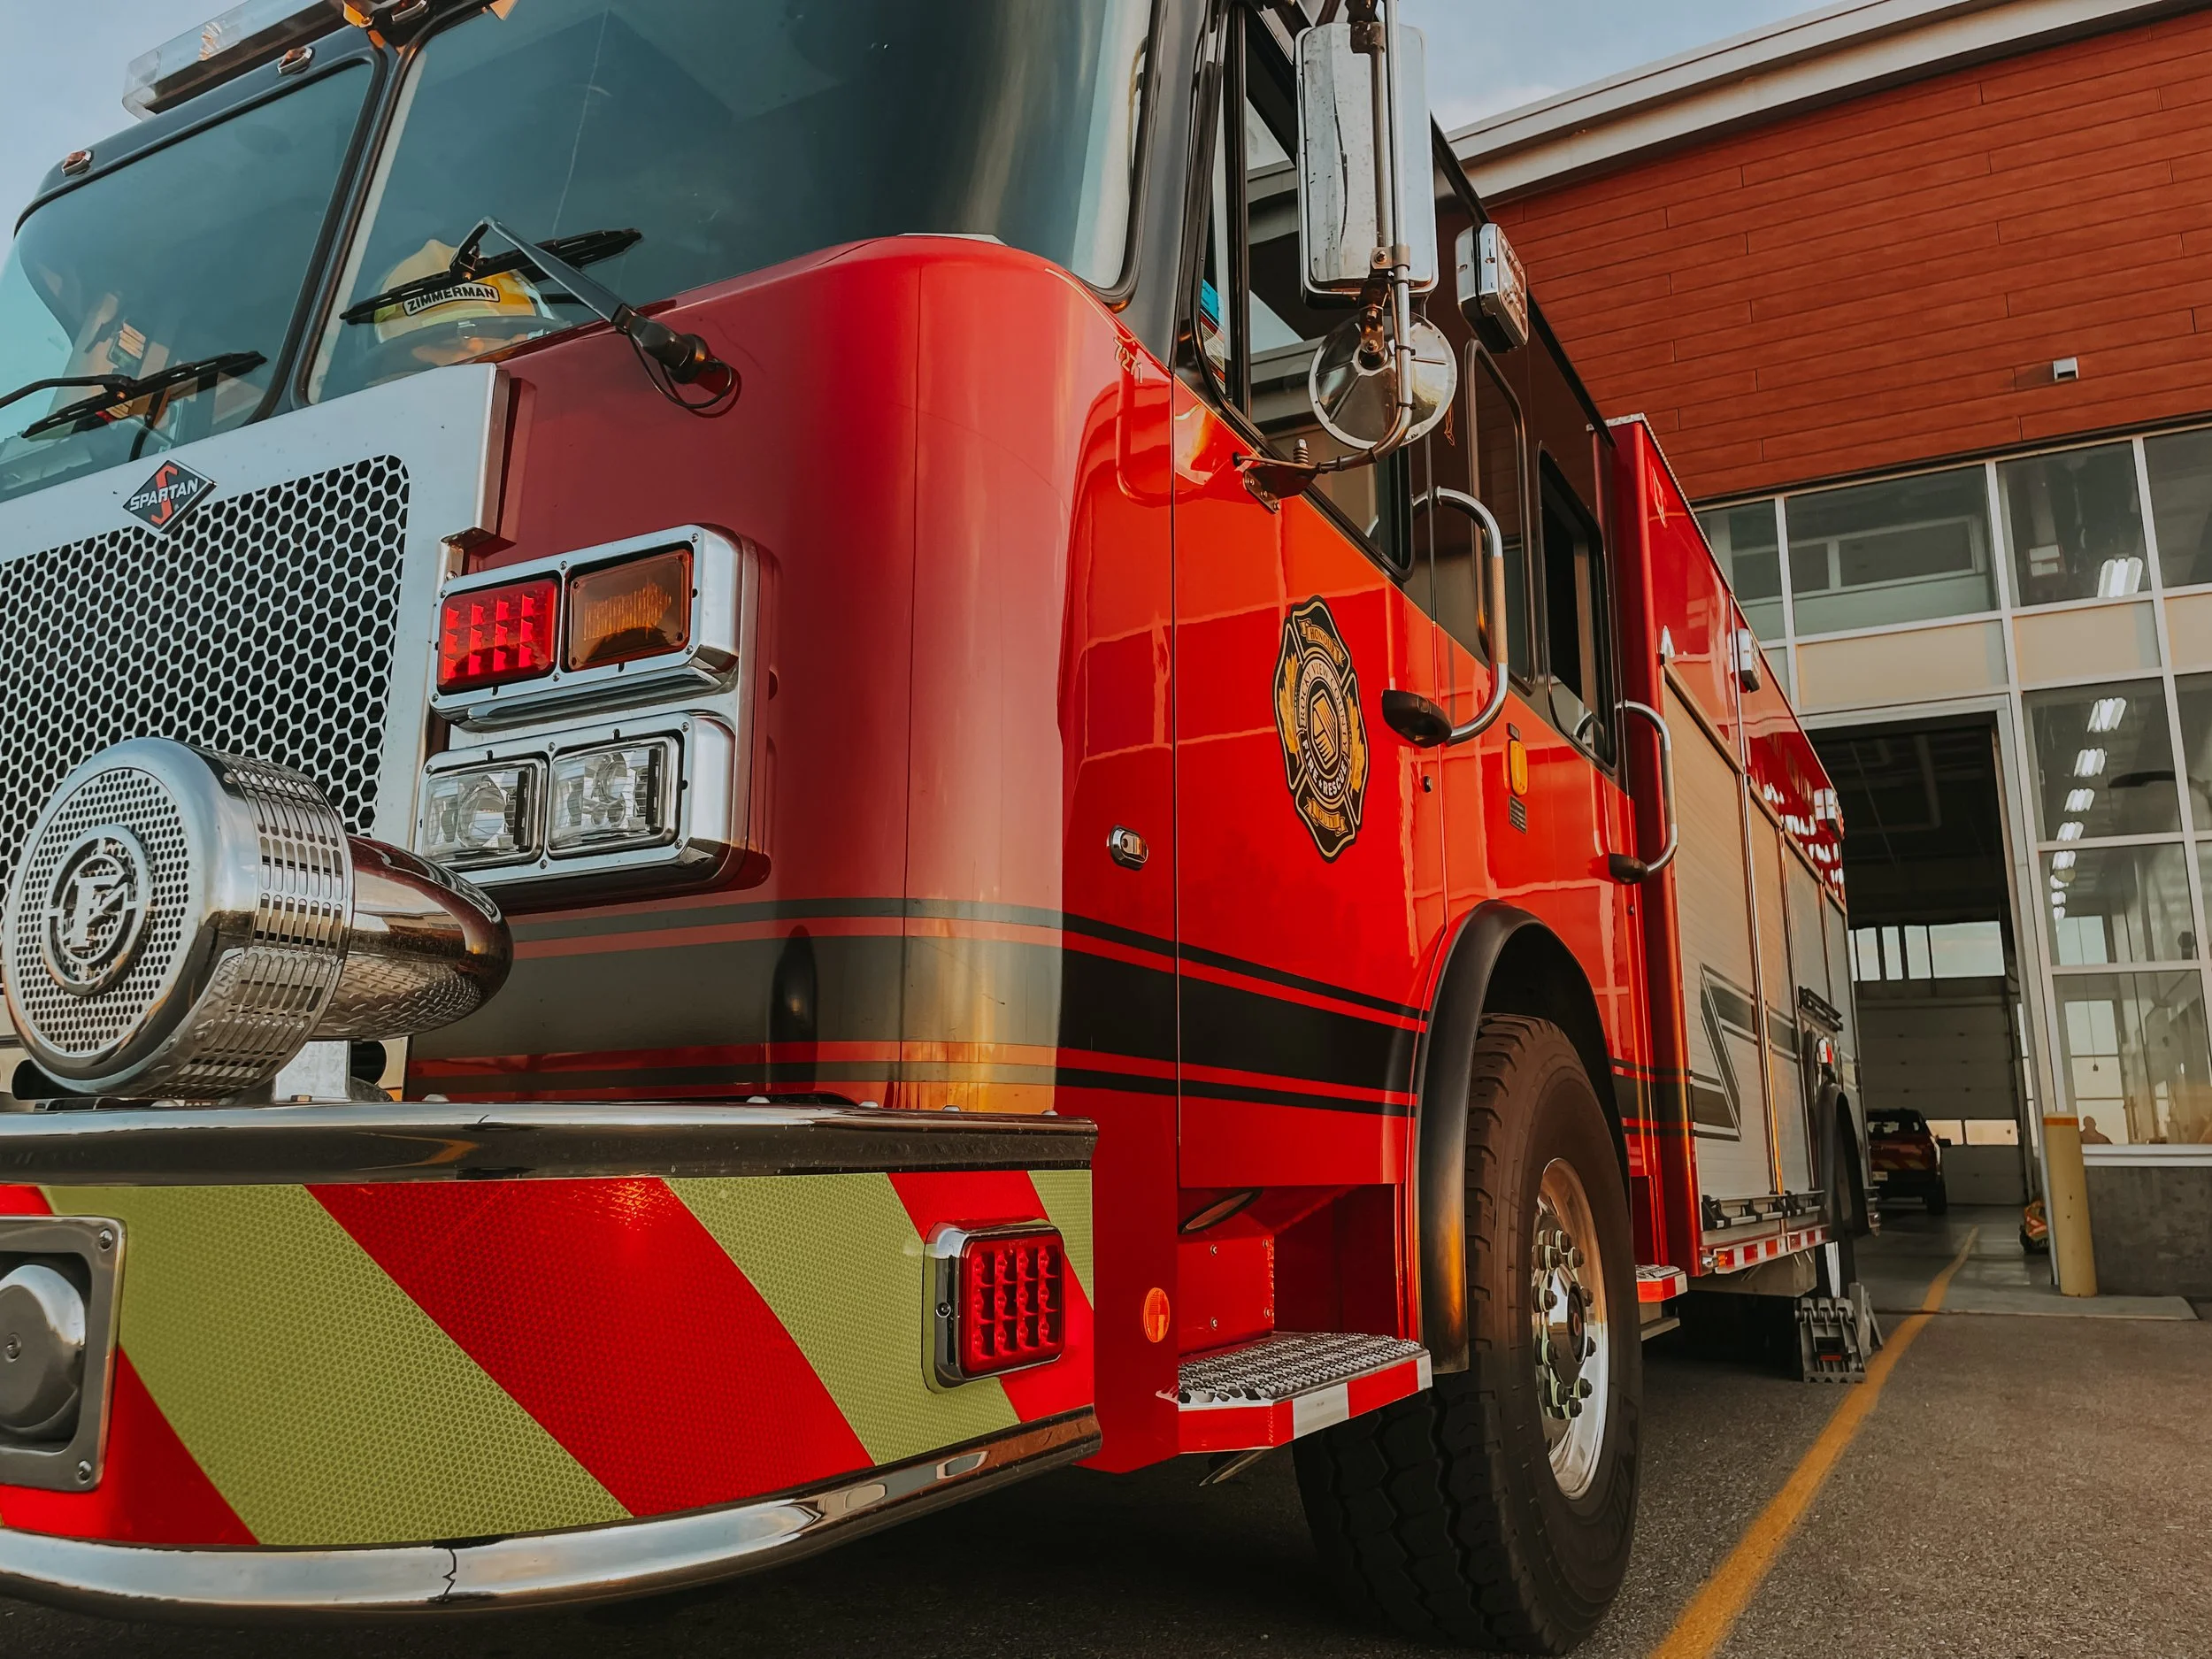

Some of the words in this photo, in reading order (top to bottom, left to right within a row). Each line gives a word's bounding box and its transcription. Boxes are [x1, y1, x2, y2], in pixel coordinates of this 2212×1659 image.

[407, 286, 495, 312] ZIMMERMAN
[1113, 337, 1143, 384] 7271
[129, 478, 198, 511] SPARTAN
[1300, 671, 1311, 721] ROCKY
[1311, 663, 1328, 679] VIEW
[1330, 678, 1348, 750] COUNTY
[1302, 740, 1318, 784] FIRE
[1323, 760, 1348, 796] RESCUE
